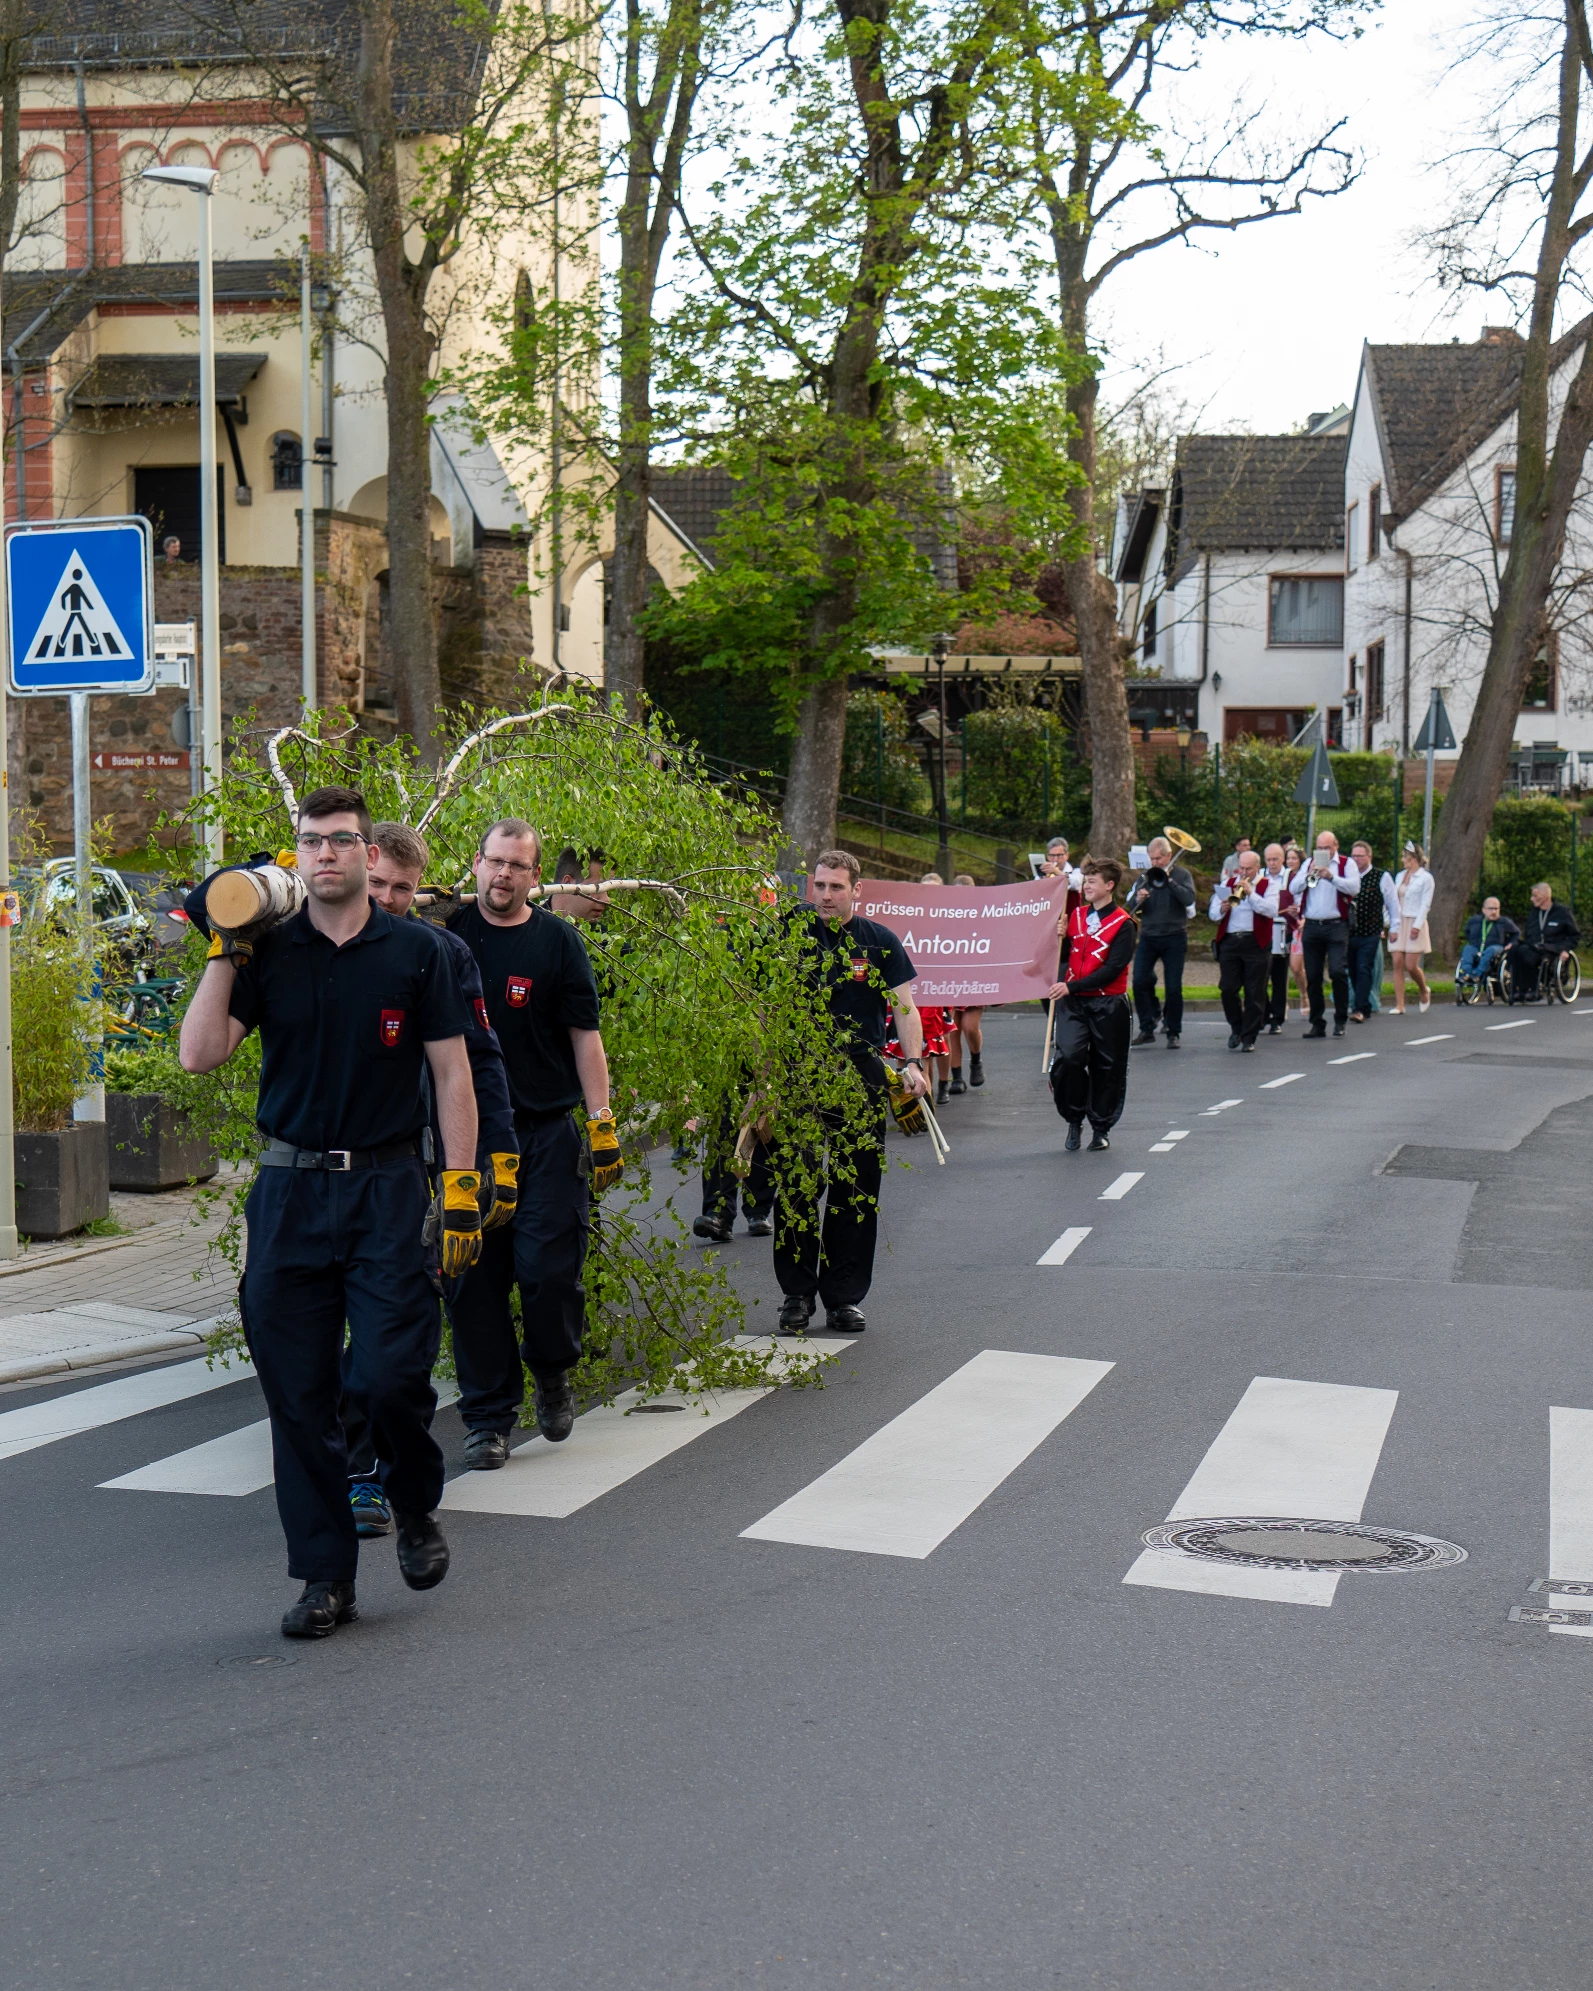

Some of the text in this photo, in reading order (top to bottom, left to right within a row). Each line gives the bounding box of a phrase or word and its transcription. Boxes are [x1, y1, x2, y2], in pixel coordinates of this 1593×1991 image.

[111, 755, 180, 766] Bücheri St. Peter
[851, 897, 1051, 919] ir grüssen unsere Maikönigin
[901, 930, 991, 955] Antonia
[920, 980, 1000, 999] Teddybären
